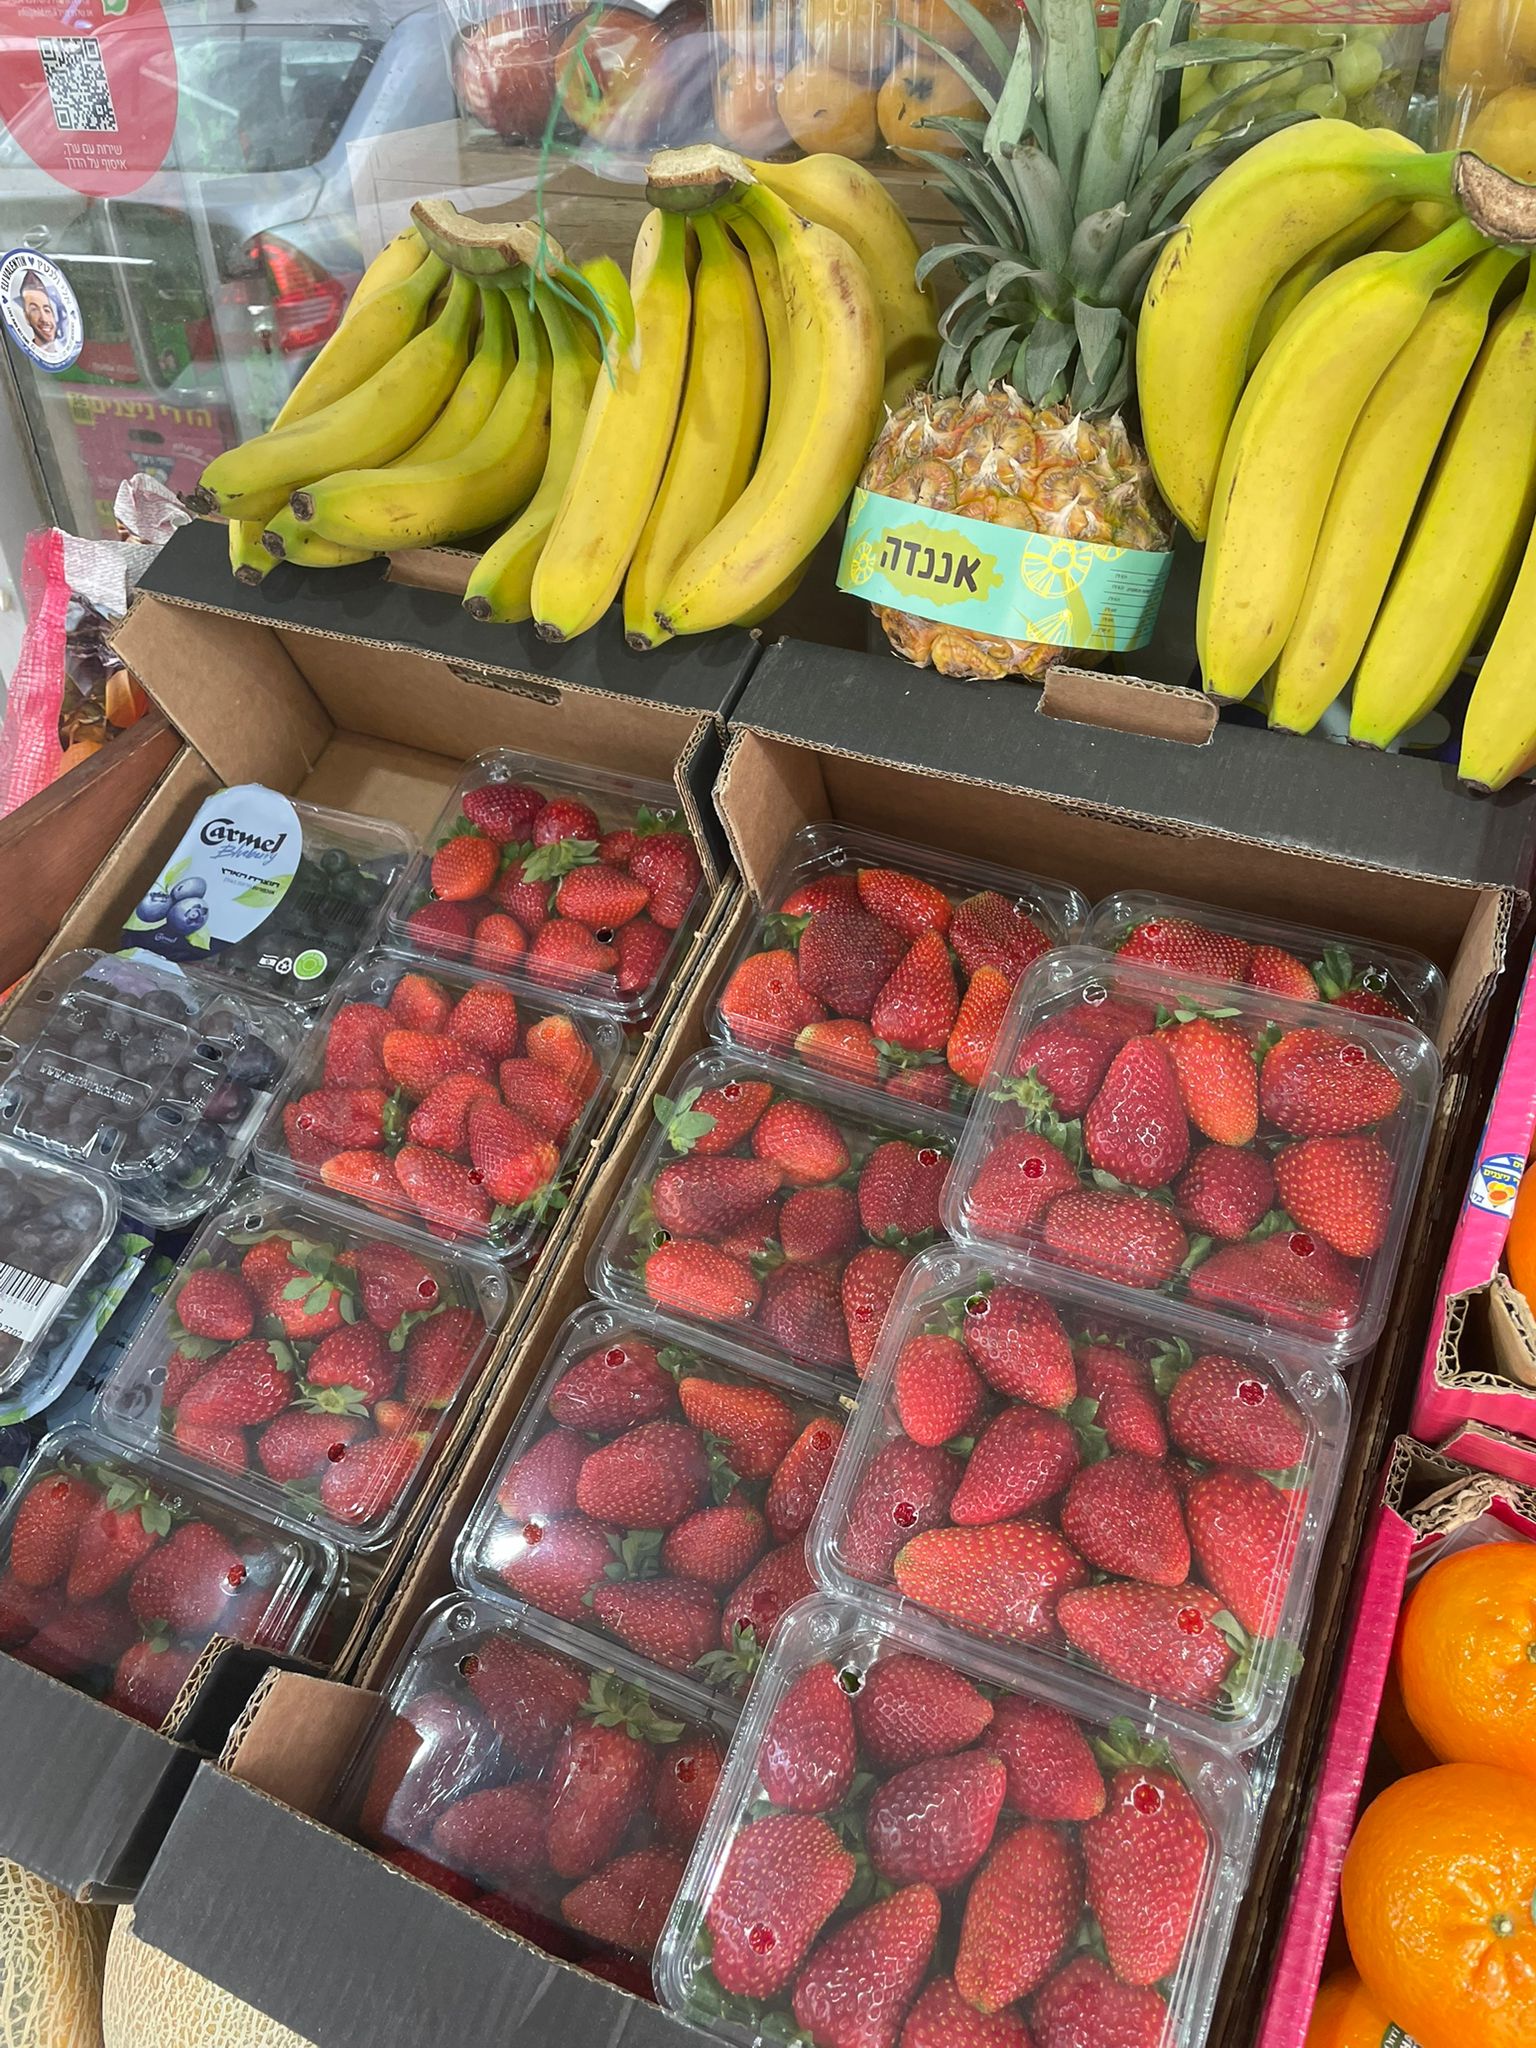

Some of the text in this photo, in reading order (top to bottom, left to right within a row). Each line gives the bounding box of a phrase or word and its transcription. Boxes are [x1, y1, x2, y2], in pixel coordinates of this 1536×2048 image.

[82, 143, 95, 154] עם
[96, 143, 123, 155] שירות
[86, 155, 100, 169] על
[101, 158, 127, 172] איסוף
[2, 255, 28, 281] VALENTIN
[159, 403, 213, 429] הדרי
[880, 535, 982, 593] אננדה
[200, 817, 288, 852] Carmel
[221, 867, 248, 879] הארץ
